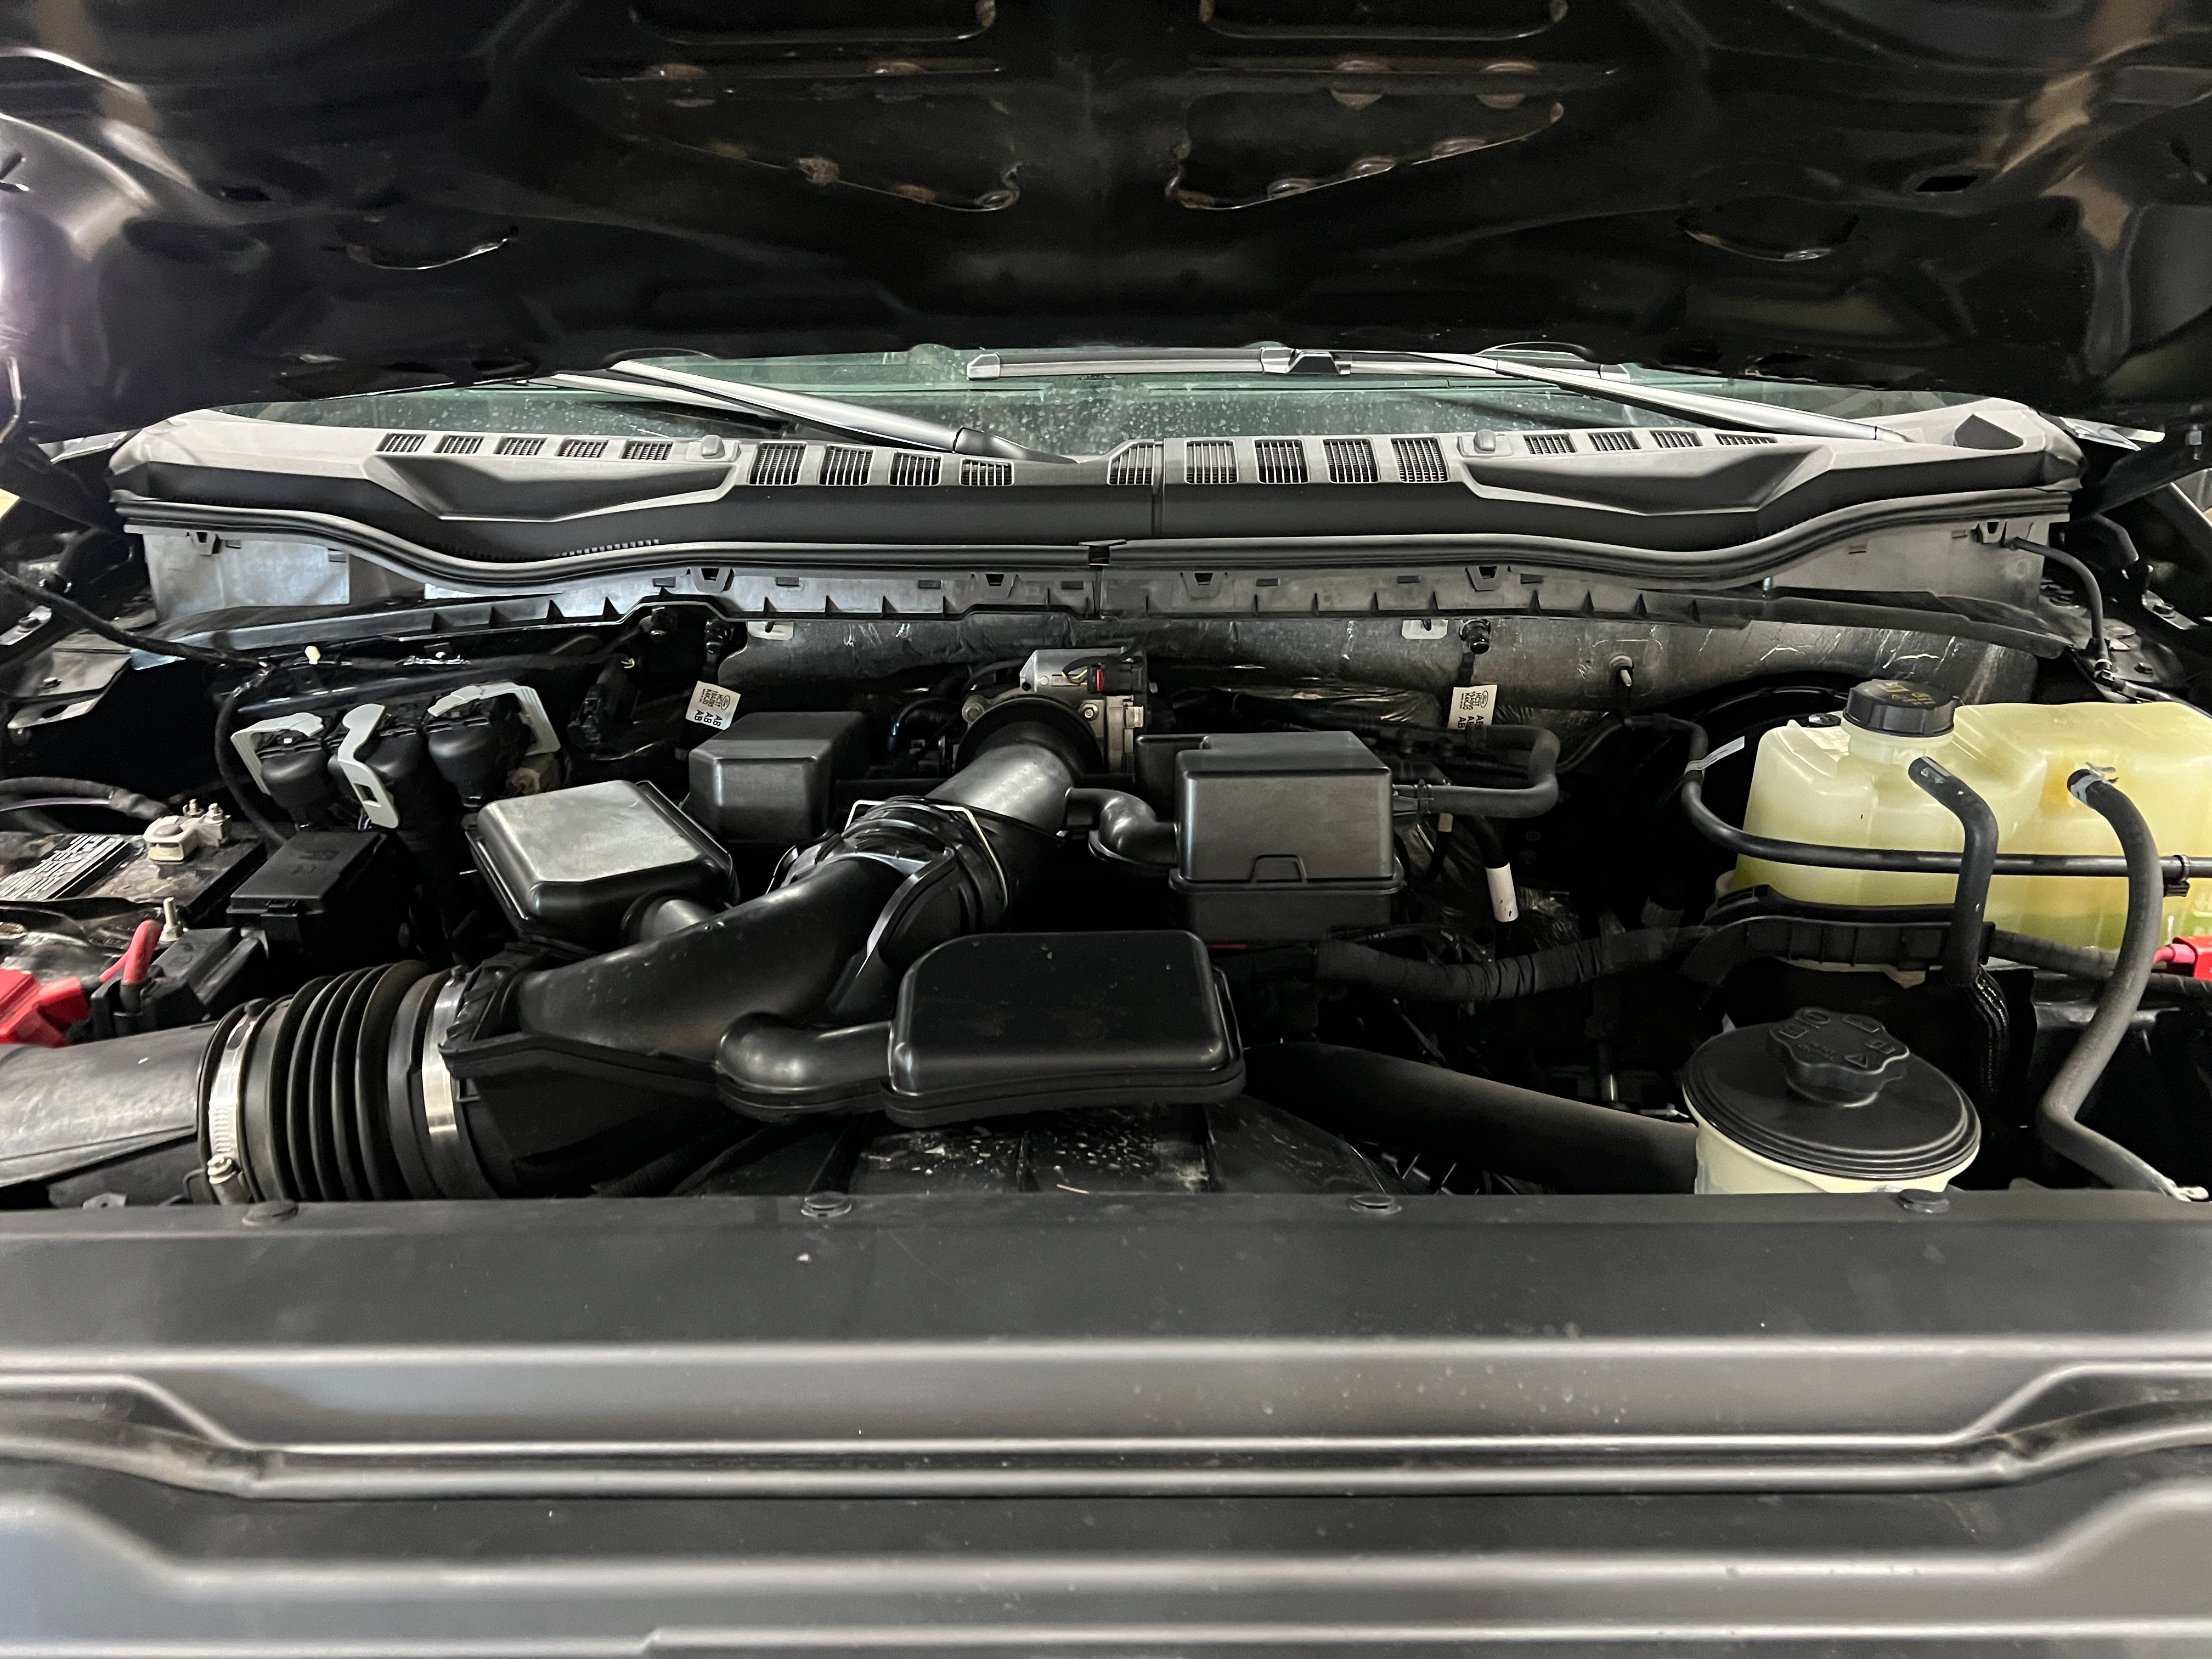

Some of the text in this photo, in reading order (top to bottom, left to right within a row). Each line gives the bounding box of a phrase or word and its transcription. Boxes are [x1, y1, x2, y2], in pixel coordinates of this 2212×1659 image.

[695, 710, 704, 721] AB
[704, 712, 713, 723] AB
[713, 715, 723, 726] AB
[1458, 716, 1466, 728] AB
